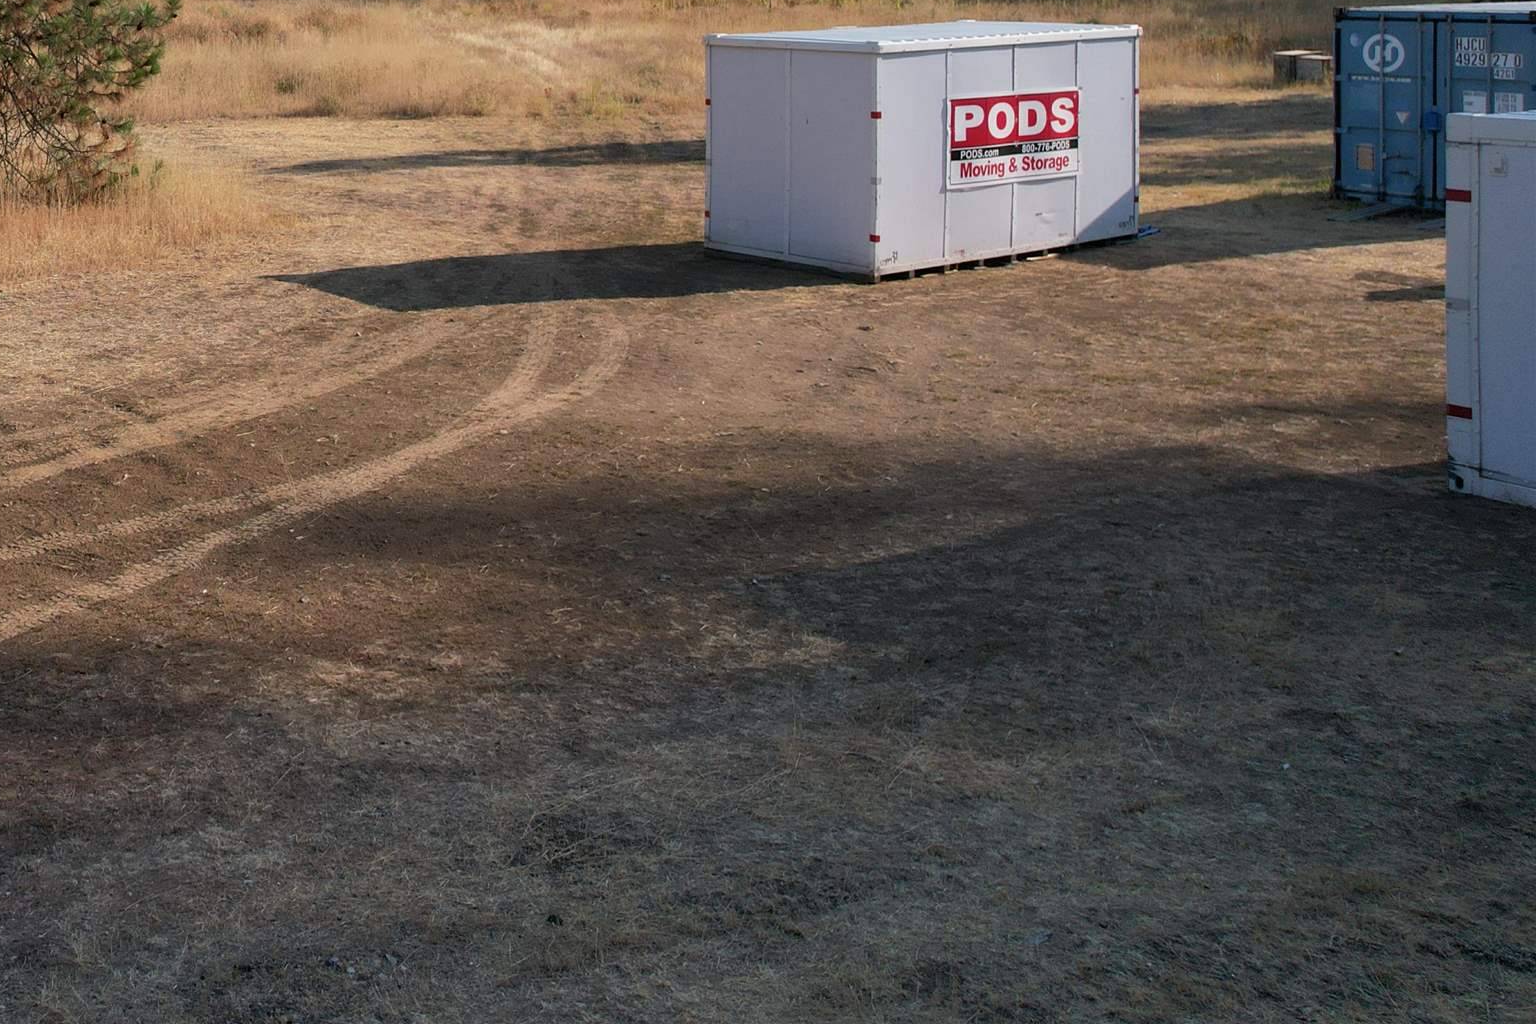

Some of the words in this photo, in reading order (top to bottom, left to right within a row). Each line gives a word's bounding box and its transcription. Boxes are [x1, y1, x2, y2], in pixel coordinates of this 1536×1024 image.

[1456, 38, 1485, 51] HJCU
[1456, 53, 1485, 66] 4929
[954, 97, 1075, 142] PODS
[960, 149, 999, 160] PODS.com
[960, 160, 1005, 178] Moving
[1009, 157, 1017, 173] &
[1022, 155, 1070, 171] Storage
